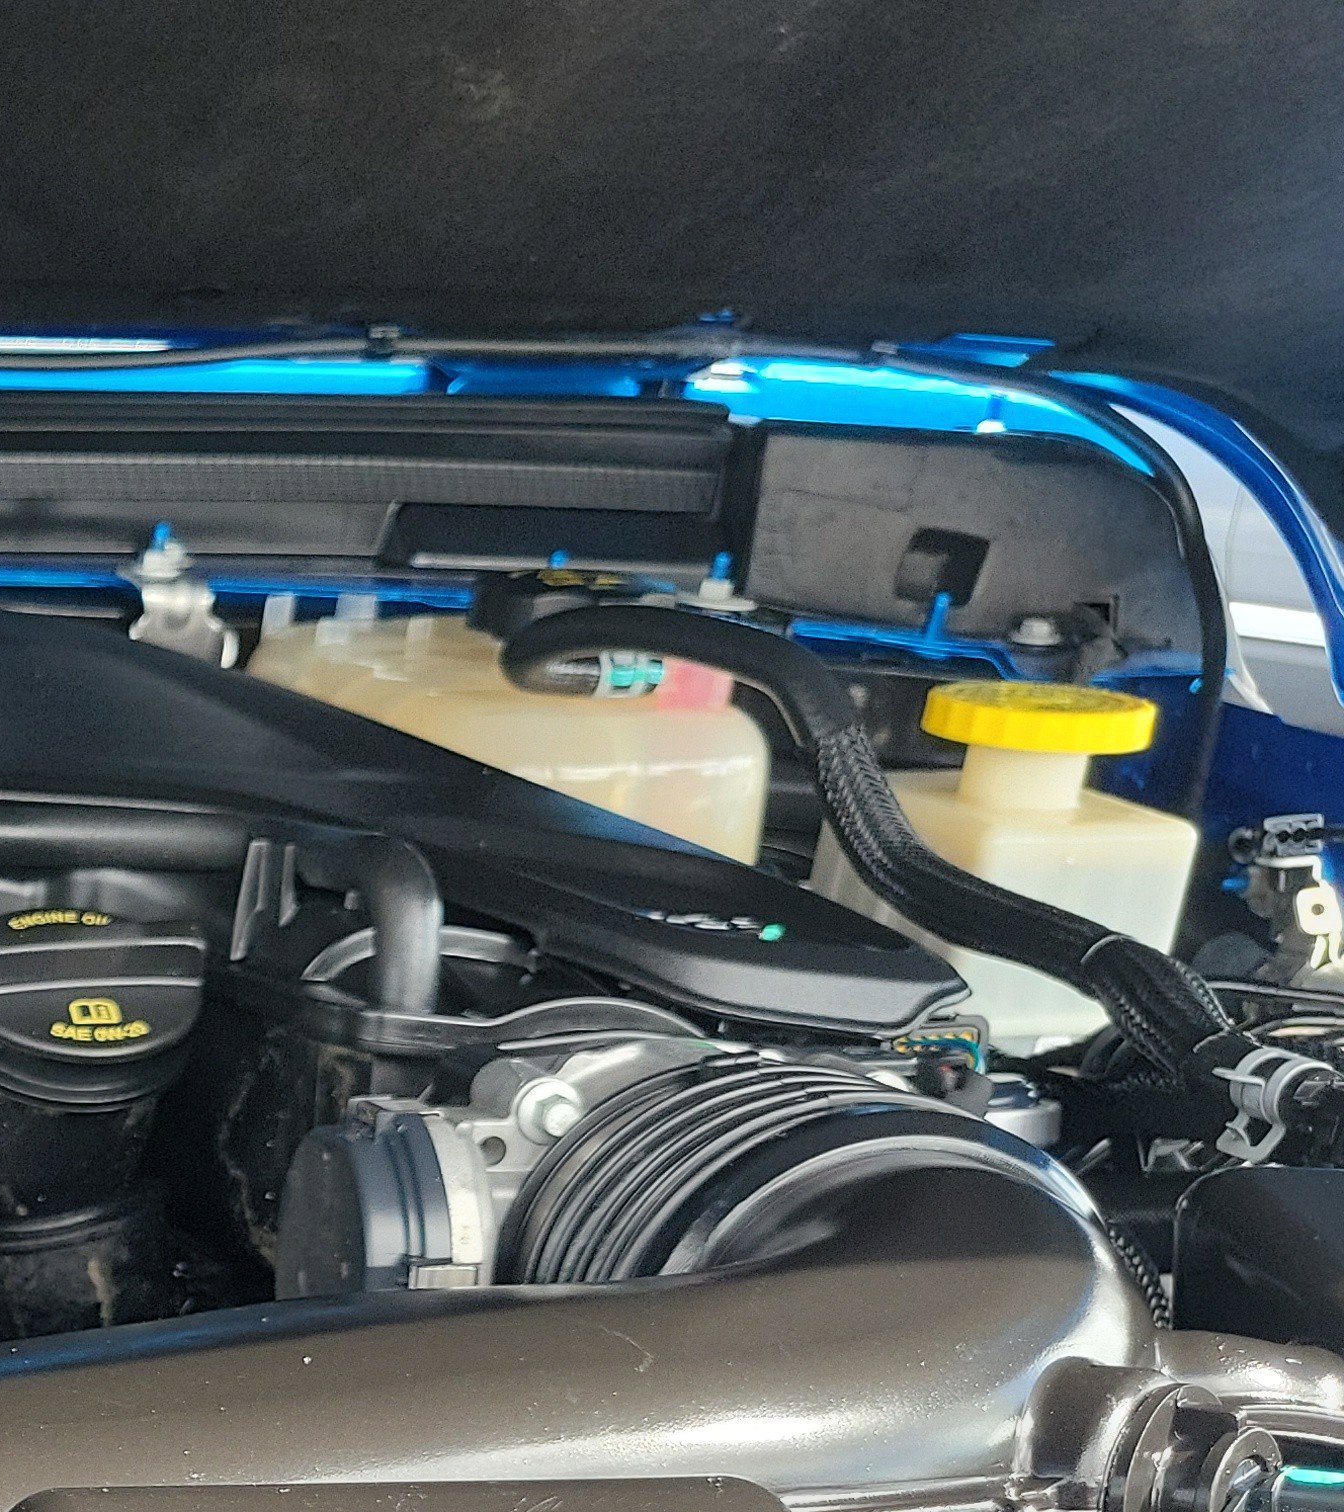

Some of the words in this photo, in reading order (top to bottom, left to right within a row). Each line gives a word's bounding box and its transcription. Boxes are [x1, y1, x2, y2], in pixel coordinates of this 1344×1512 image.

[7, 910, 79, 930] ENGINE
[81, 911, 111, 927] OIL
[50, 1021, 92, 1042] SAE
